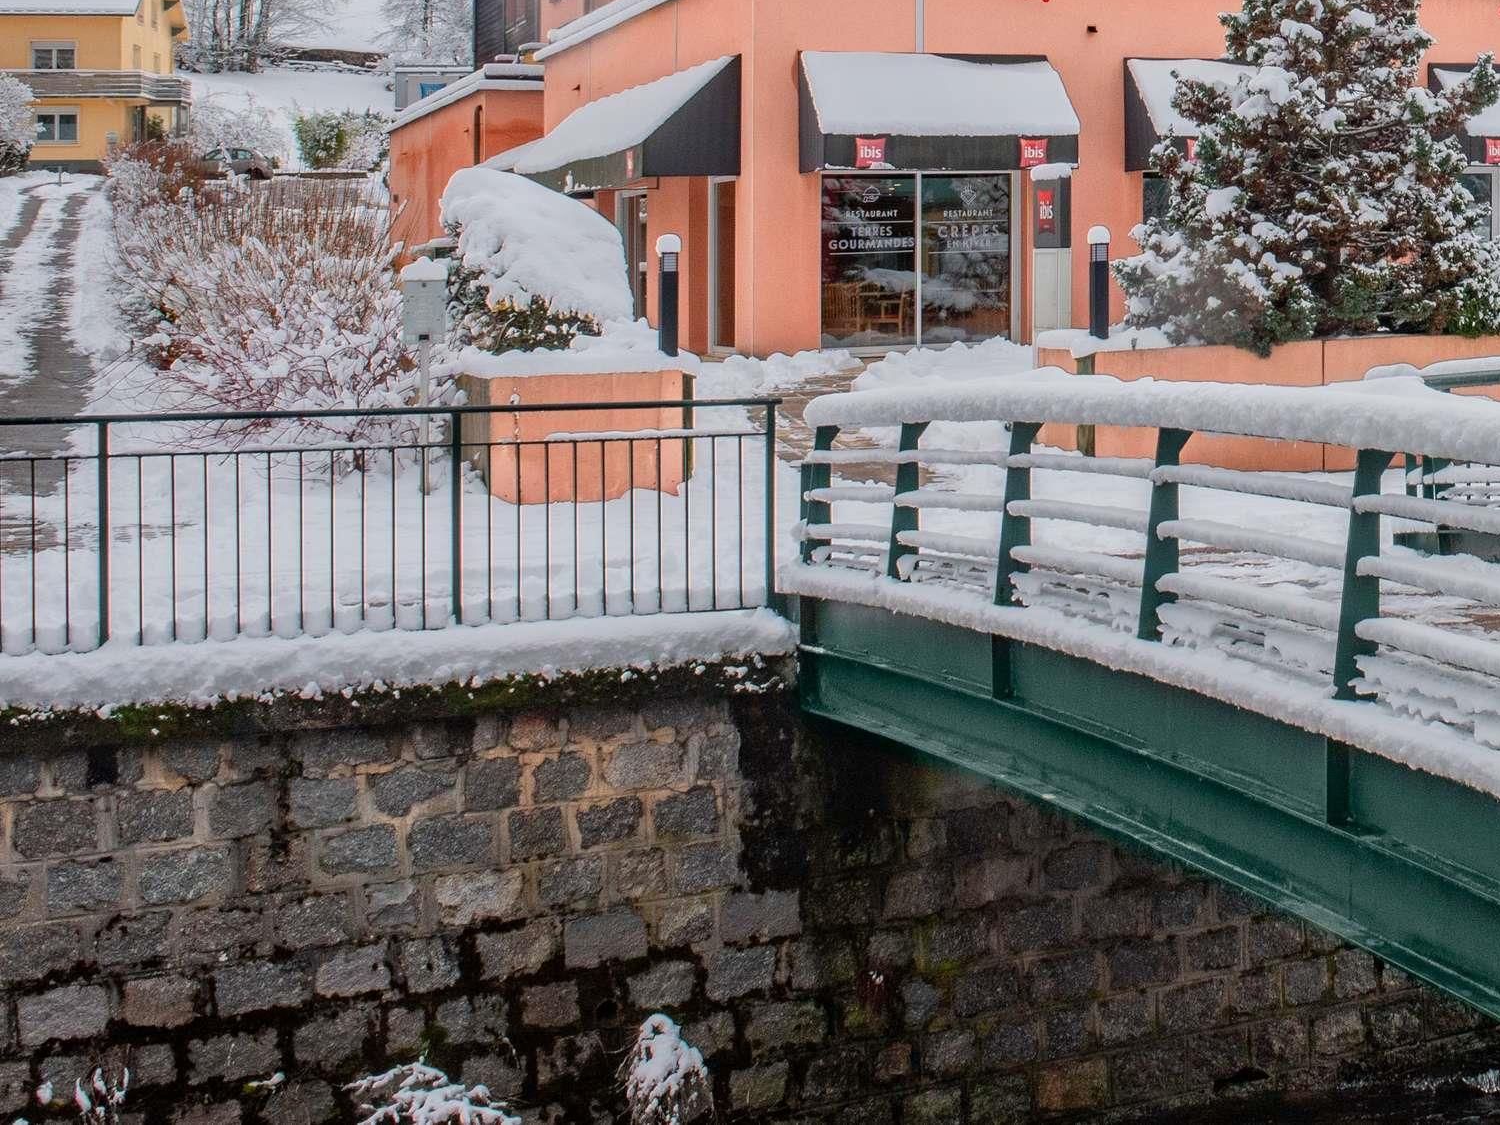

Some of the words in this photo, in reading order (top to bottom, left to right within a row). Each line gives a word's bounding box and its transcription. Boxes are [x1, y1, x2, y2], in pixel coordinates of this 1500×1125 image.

[860, 145, 882, 159] ibis
[1024, 146, 1044, 159] ibis
[845, 209, 899, 219] RESTAURANT
[943, 209, 994, 218] RESTAURANT
[1040, 202, 1053, 220] ibis
[851, 226, 893, 237] TERRES
[828, 236, 915, 250] GOURMANDES
